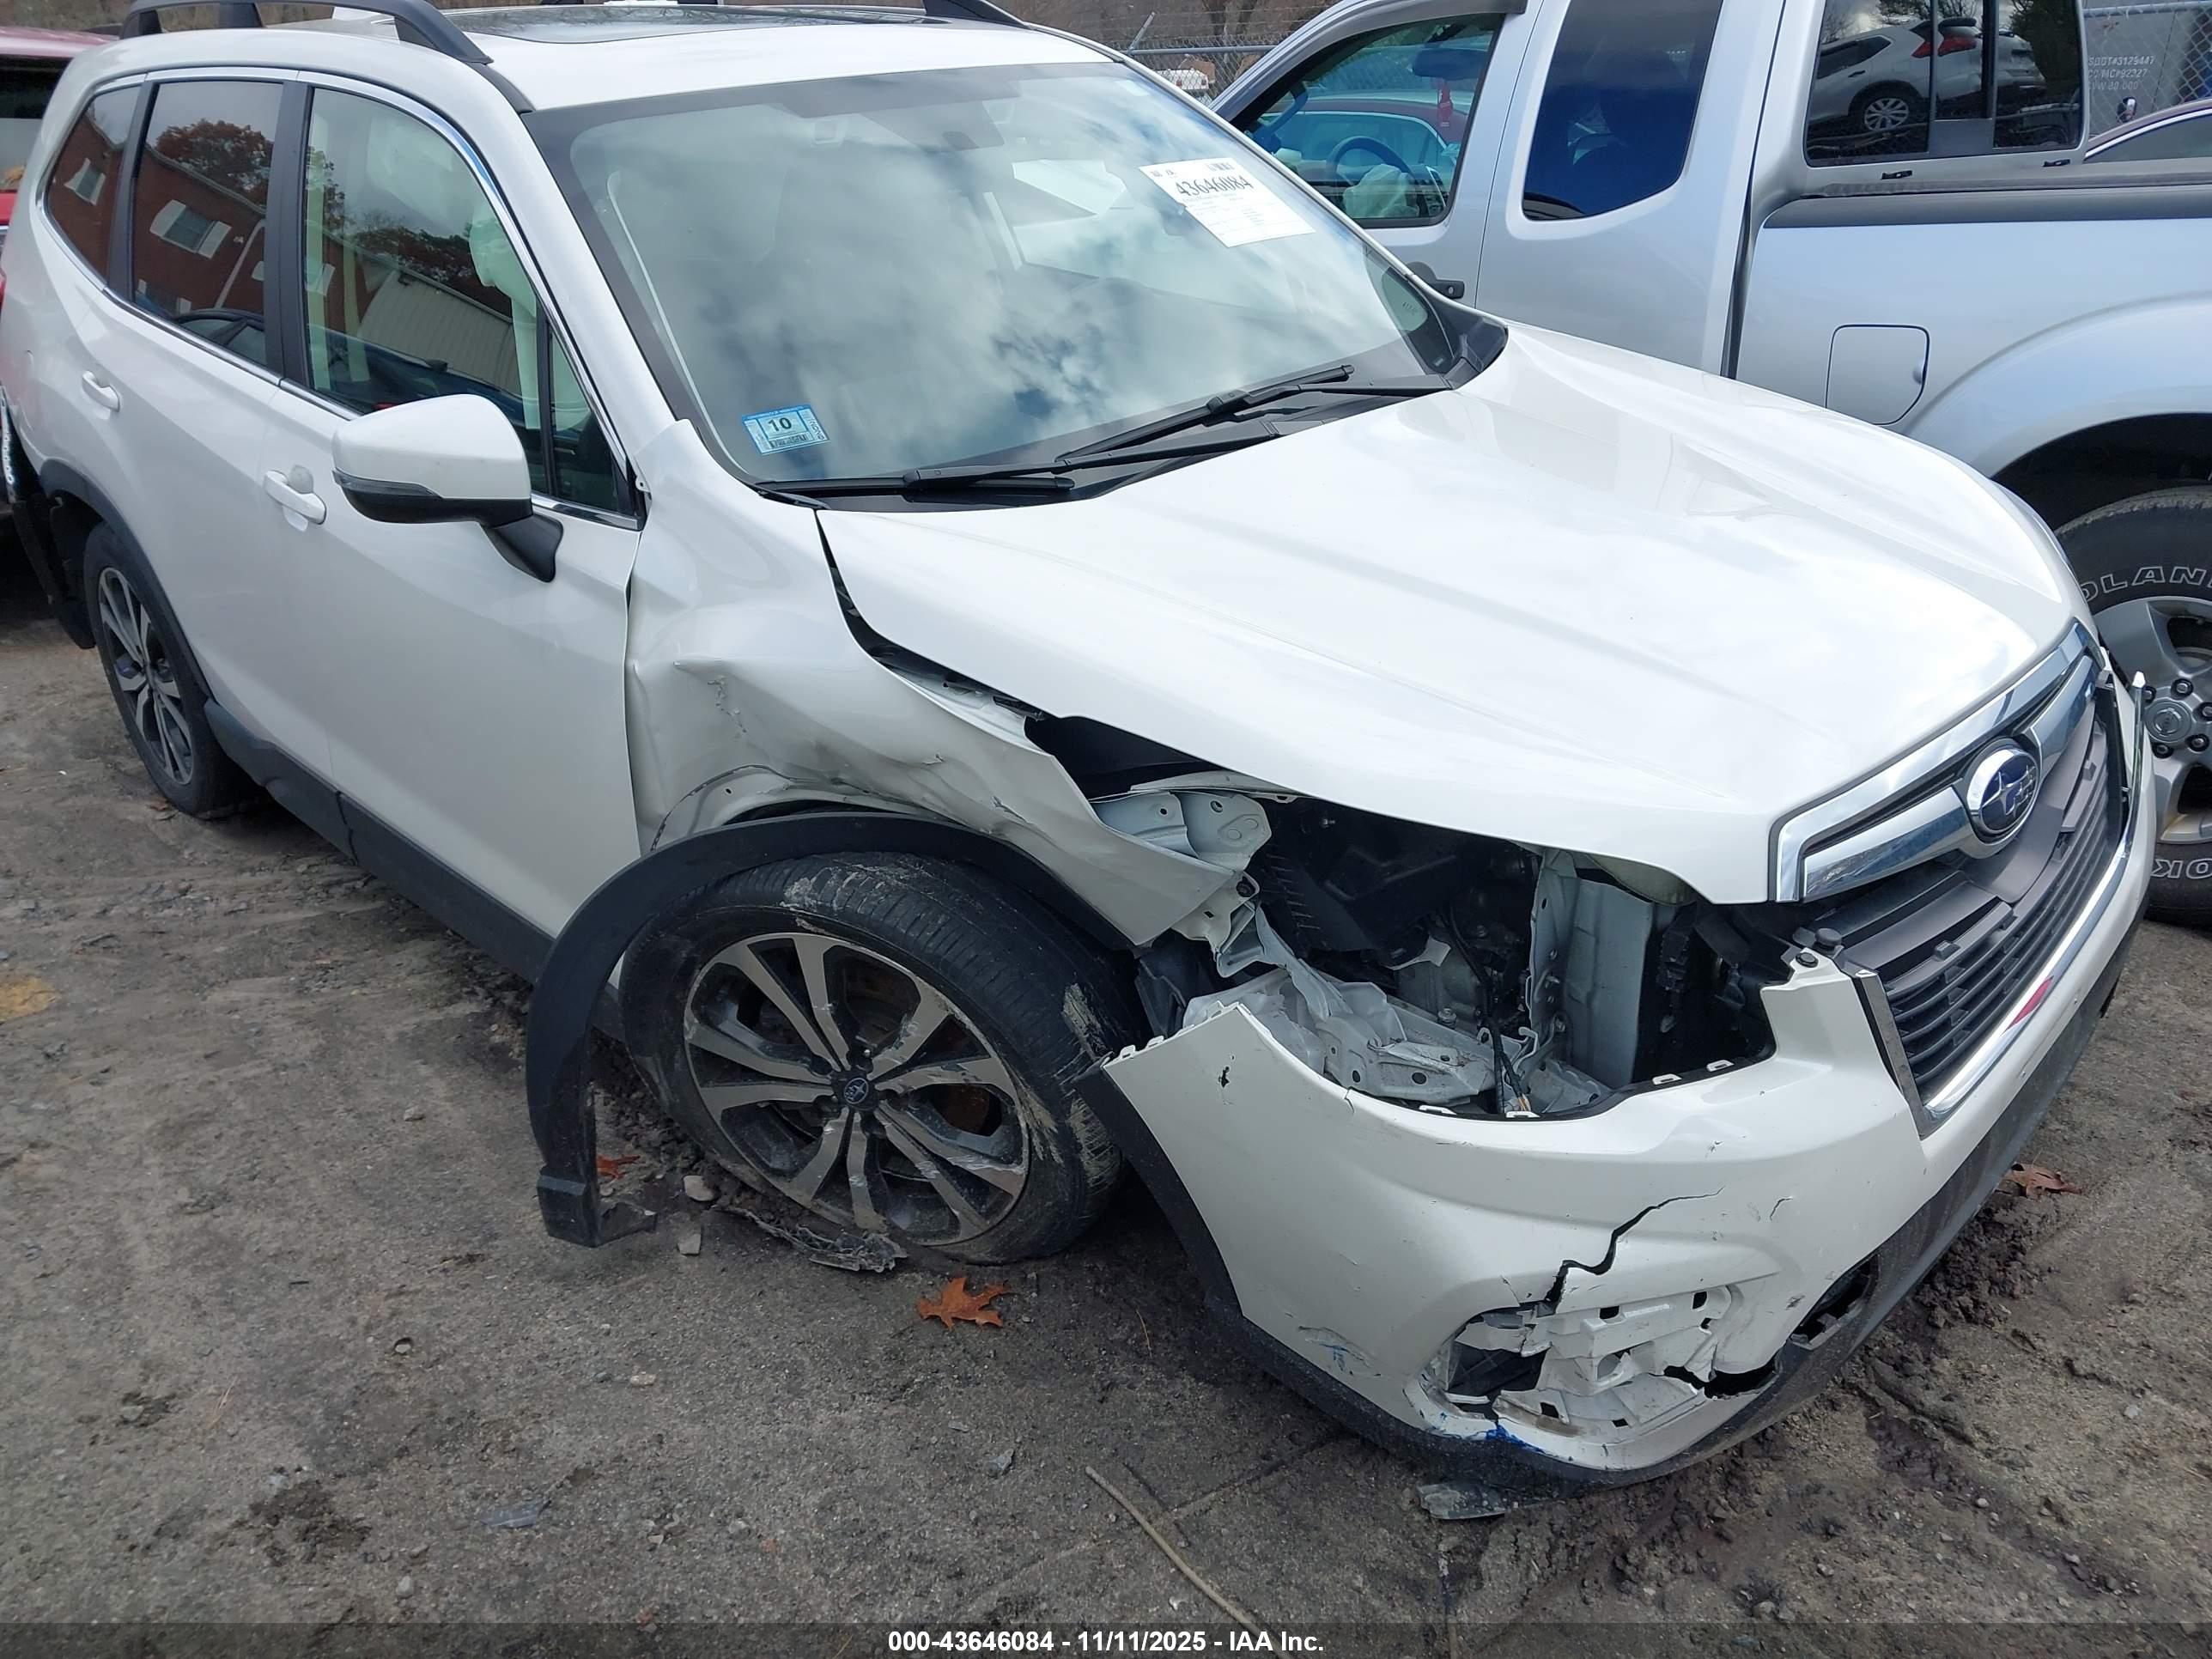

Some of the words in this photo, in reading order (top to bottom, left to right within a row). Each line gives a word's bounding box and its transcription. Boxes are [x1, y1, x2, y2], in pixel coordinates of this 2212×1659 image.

[1175, 174, 1255, 197] 43646084
[768, 416, 793, 432] 10
[2080, 566, 2212, 603] OLAN
